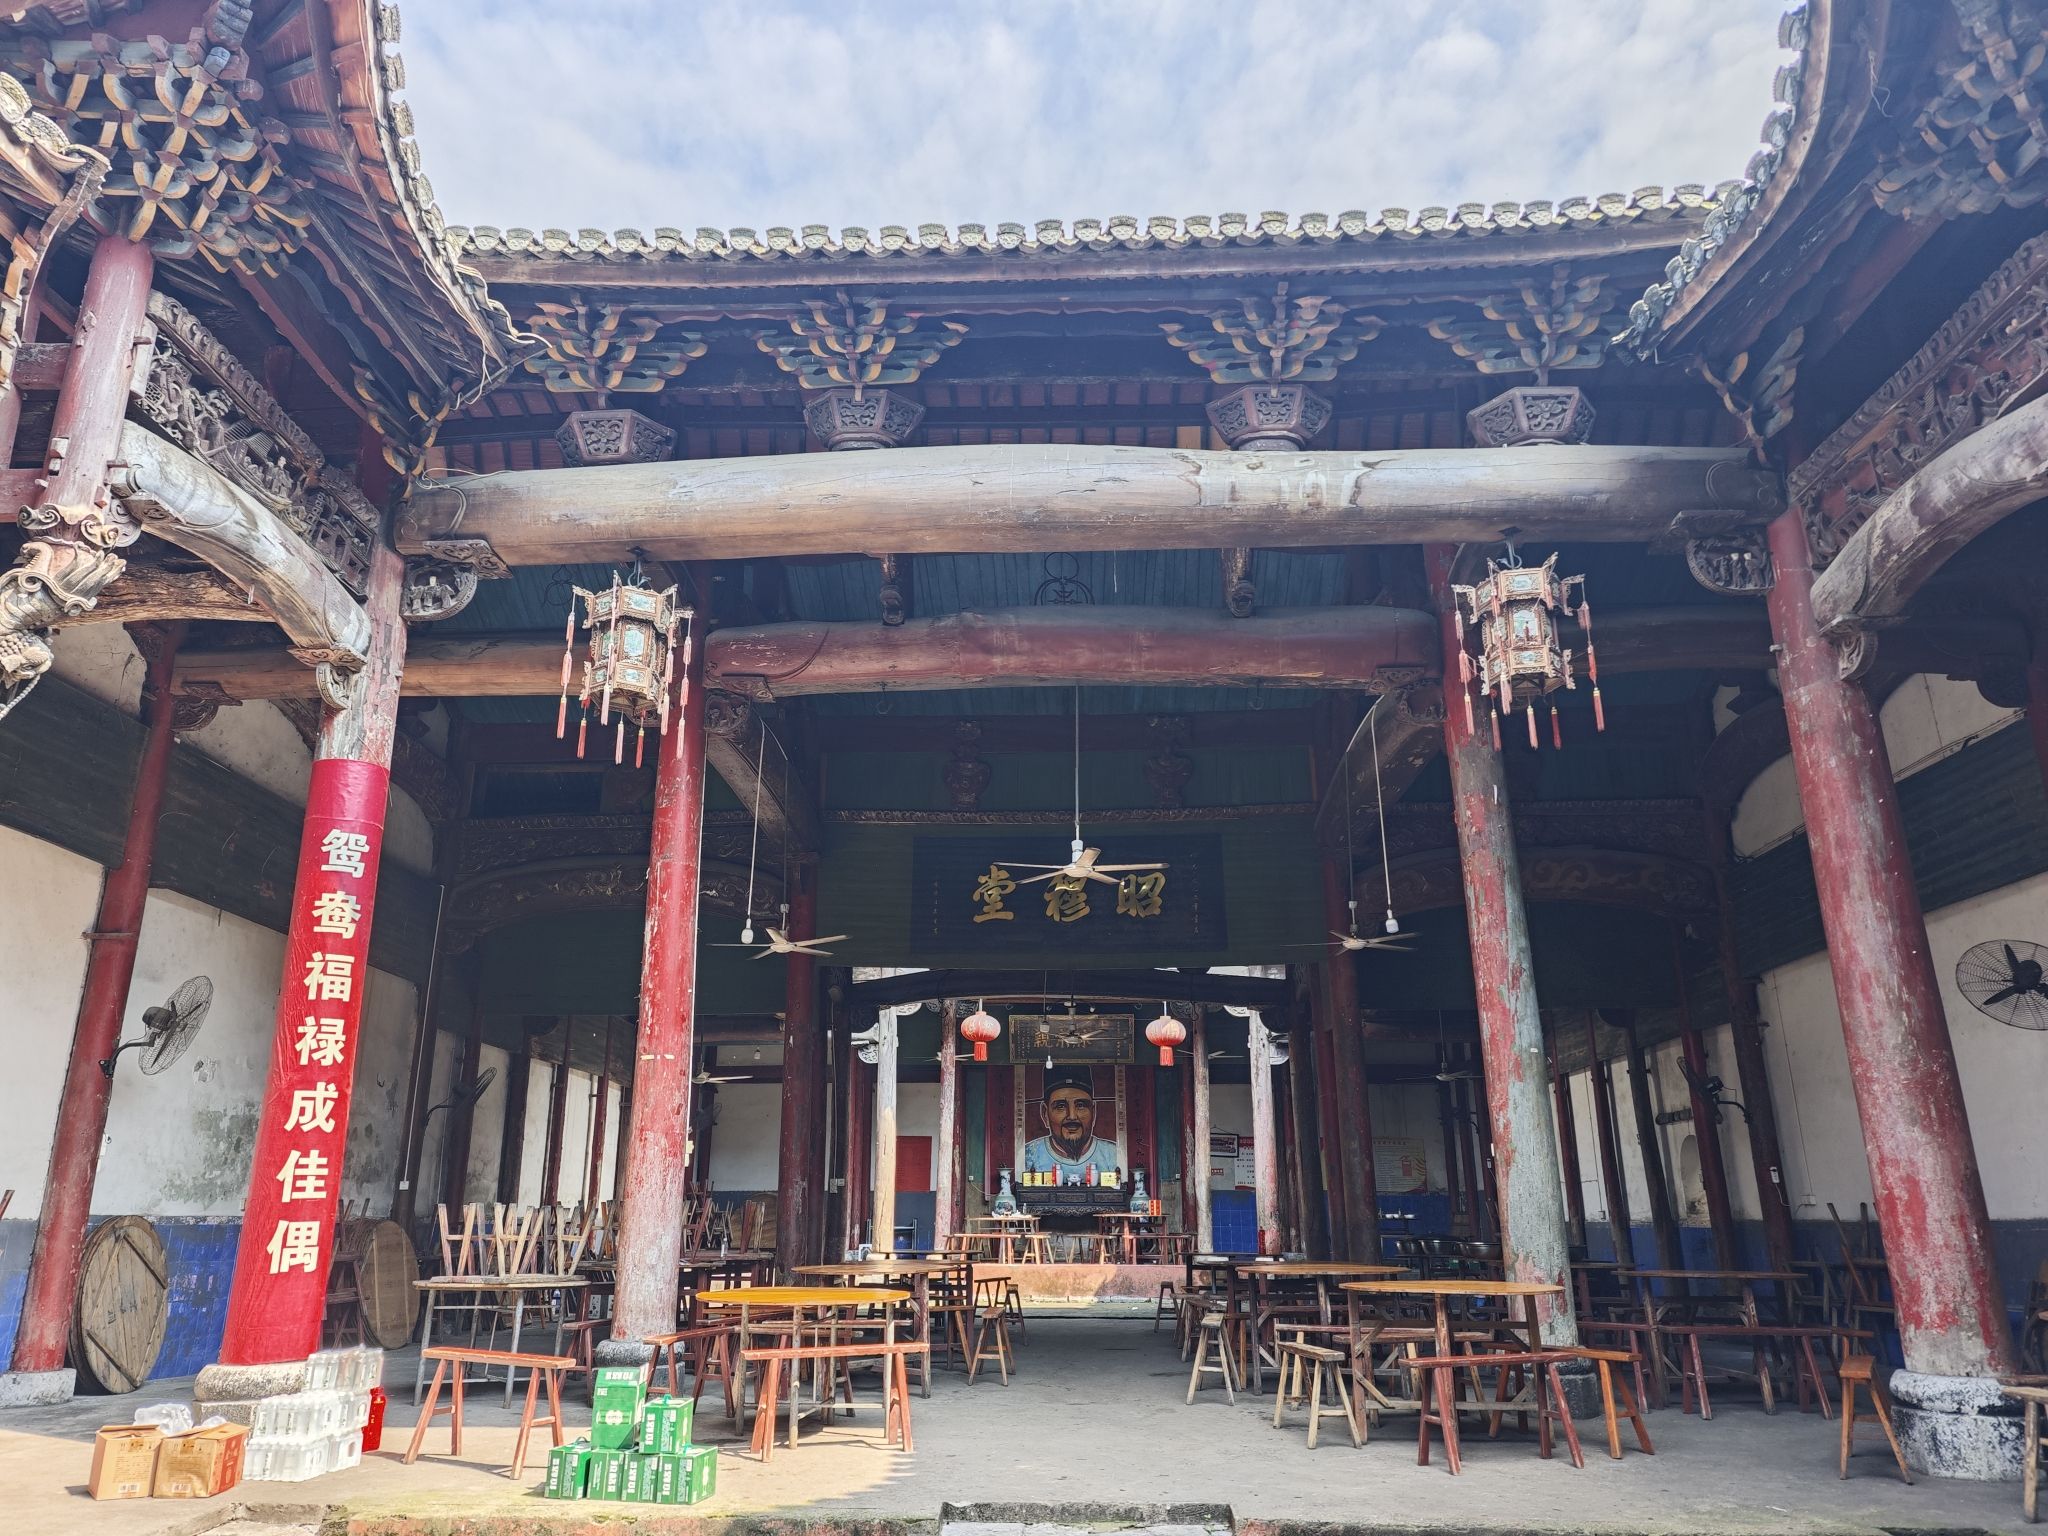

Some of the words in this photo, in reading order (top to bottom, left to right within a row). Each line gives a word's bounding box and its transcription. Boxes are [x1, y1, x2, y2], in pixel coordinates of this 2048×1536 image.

[973, 864, 1167, 924] 昭穆堂
[266, 828, 370, 1275] 鸳鸯福禄成佳偶
